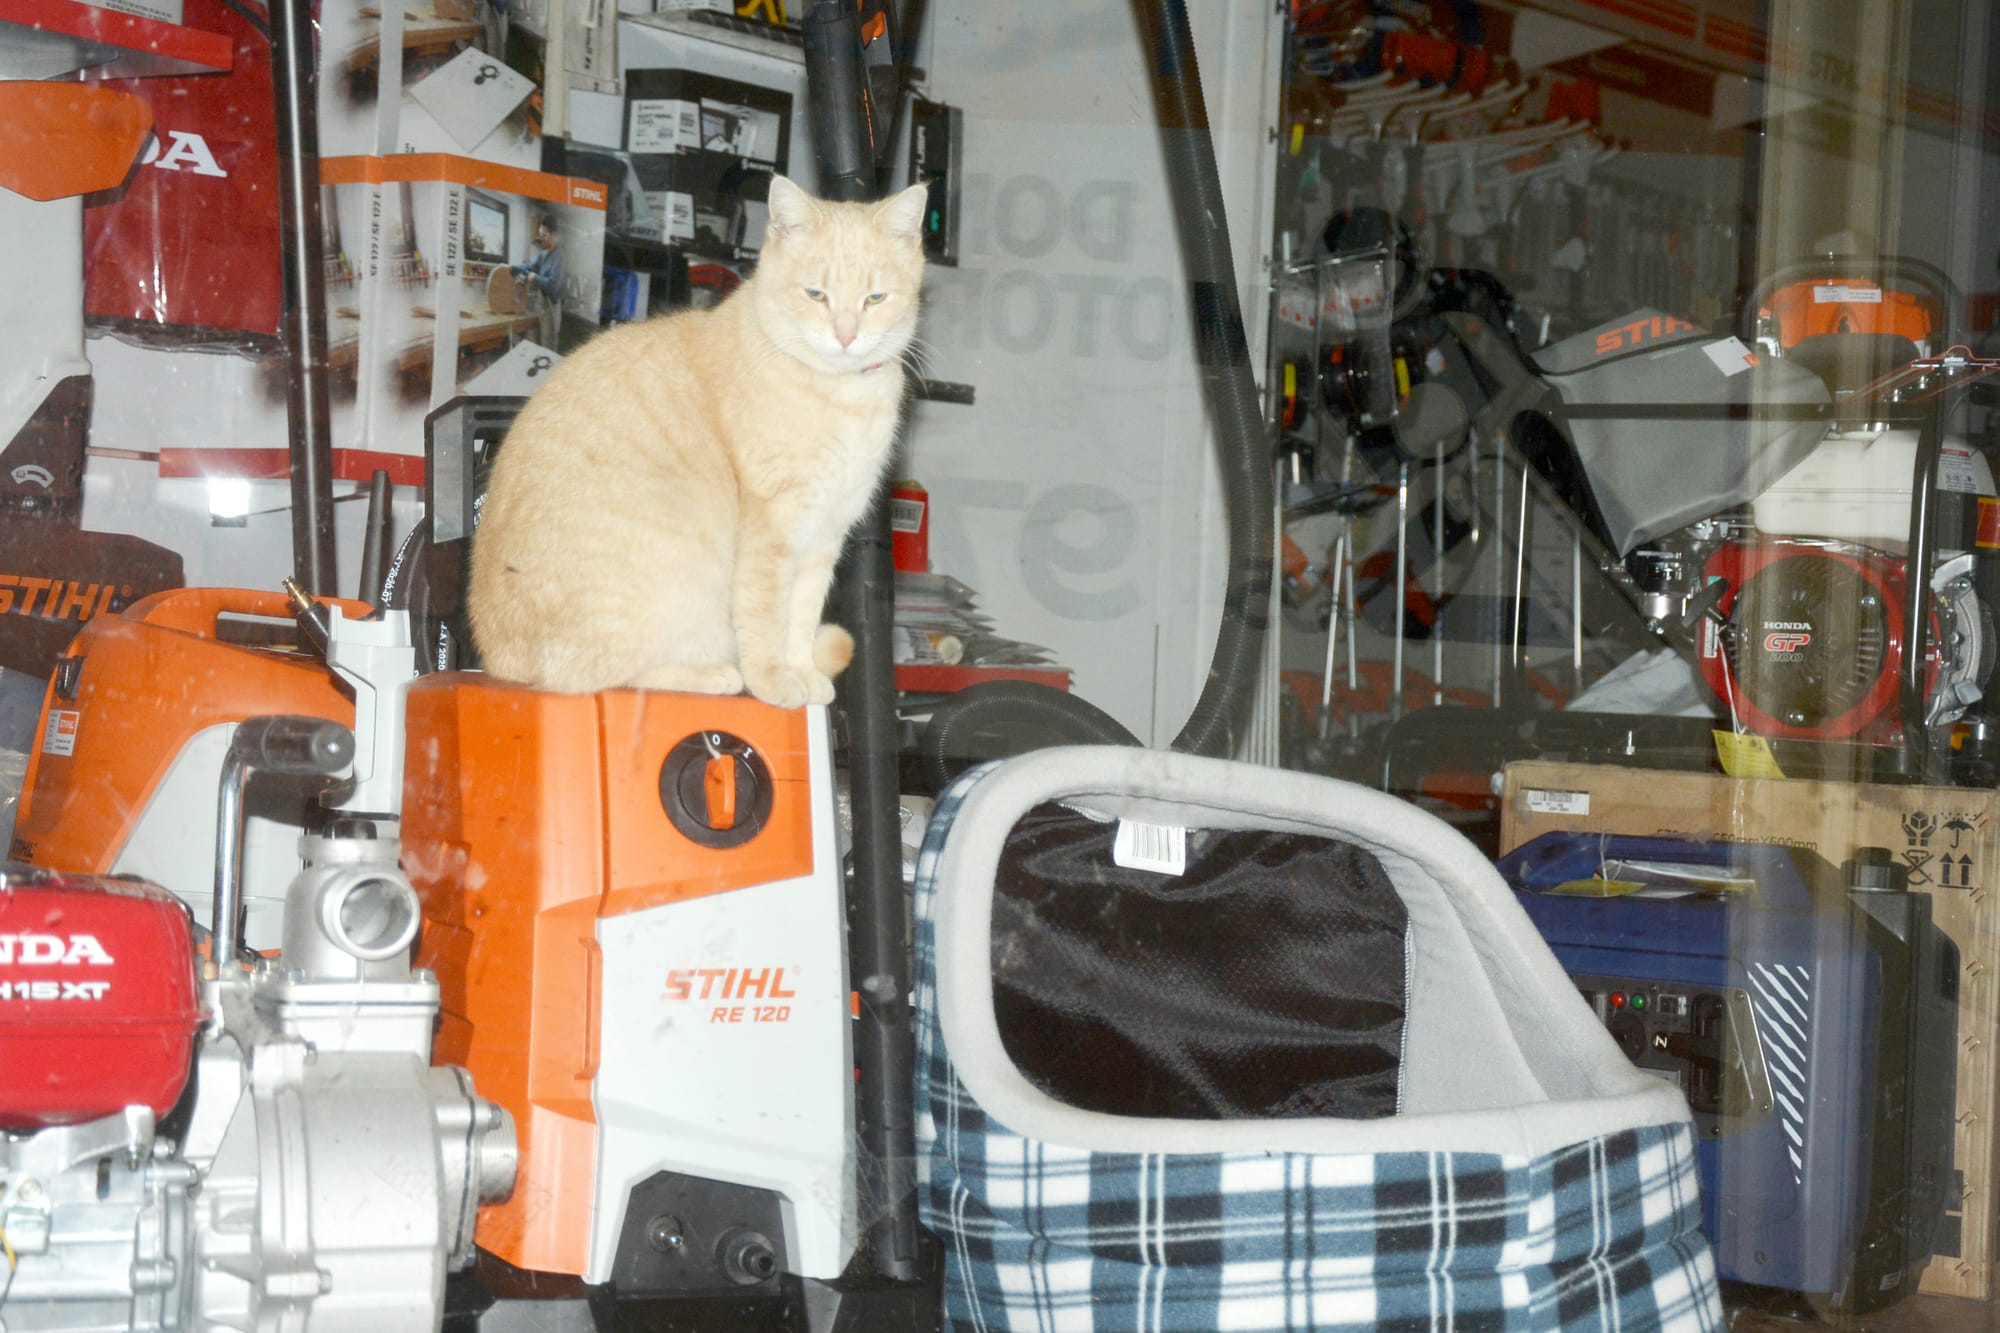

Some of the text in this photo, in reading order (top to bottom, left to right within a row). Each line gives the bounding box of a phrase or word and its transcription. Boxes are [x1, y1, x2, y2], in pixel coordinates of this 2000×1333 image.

[574, 187, 602, 202] STIHL
[449, 199, 459, 217] 122
[448, 220, 458, 234] SE
[447, 241, 457, 259] 122
[446, 263, 456, 277] SE
[1763, 621, 1812, 631] HONDA
[1764, 632, 1811, 653] GP
[659, 966, 797, 1000] STIHL
[709, 1005, 792, 1024] RE 120
